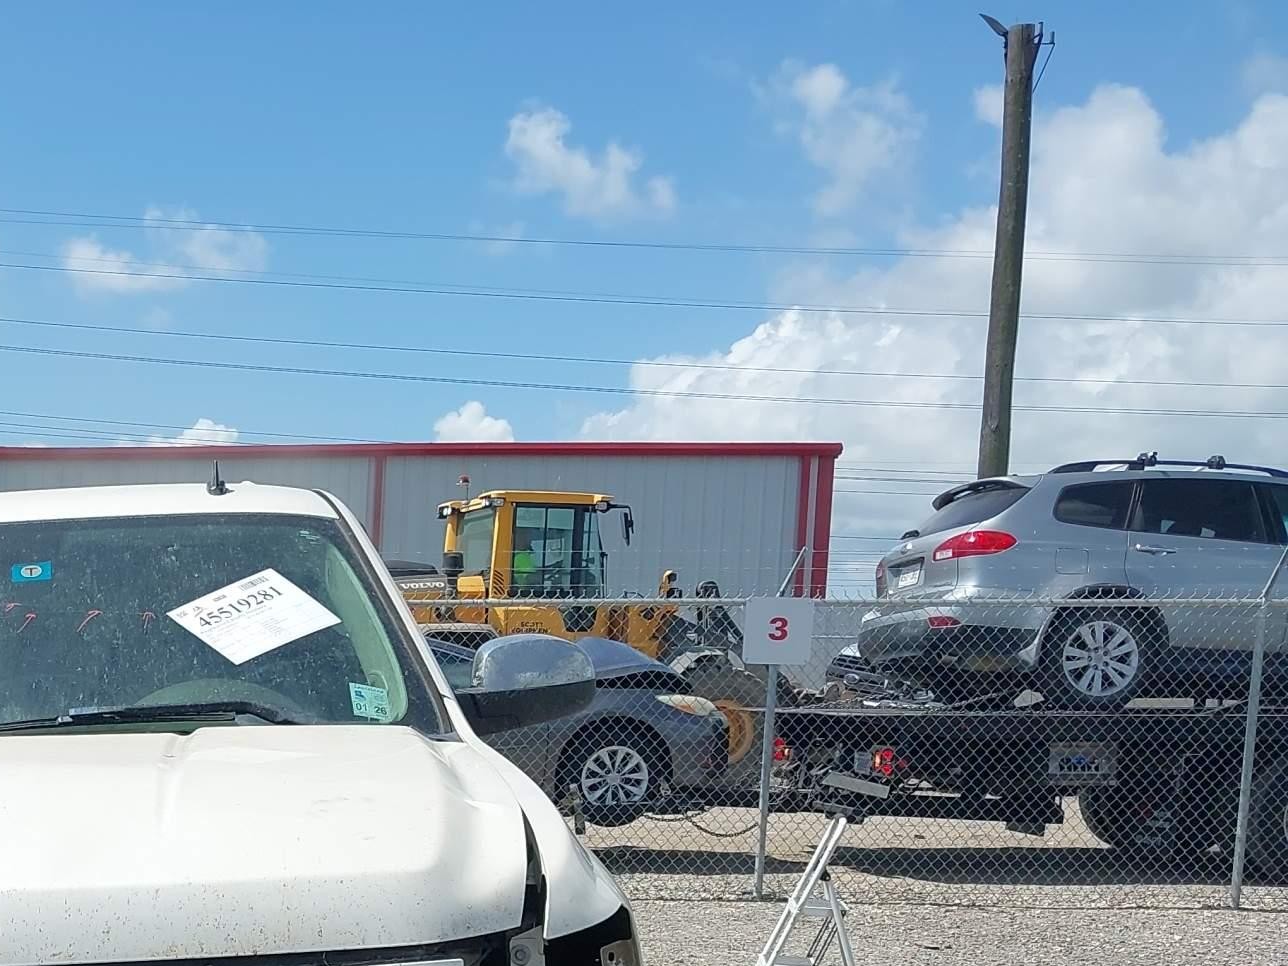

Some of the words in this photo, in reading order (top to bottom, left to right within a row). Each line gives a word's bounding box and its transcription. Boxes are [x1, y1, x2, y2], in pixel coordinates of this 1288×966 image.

[399, 581, 445, 589] VOLVO
[199, 586, 283, 628] 45519281
[768, 617, 788, 641] 3
[355, 702, 368, 712] 01
[374, 706, 387, 716] 26
